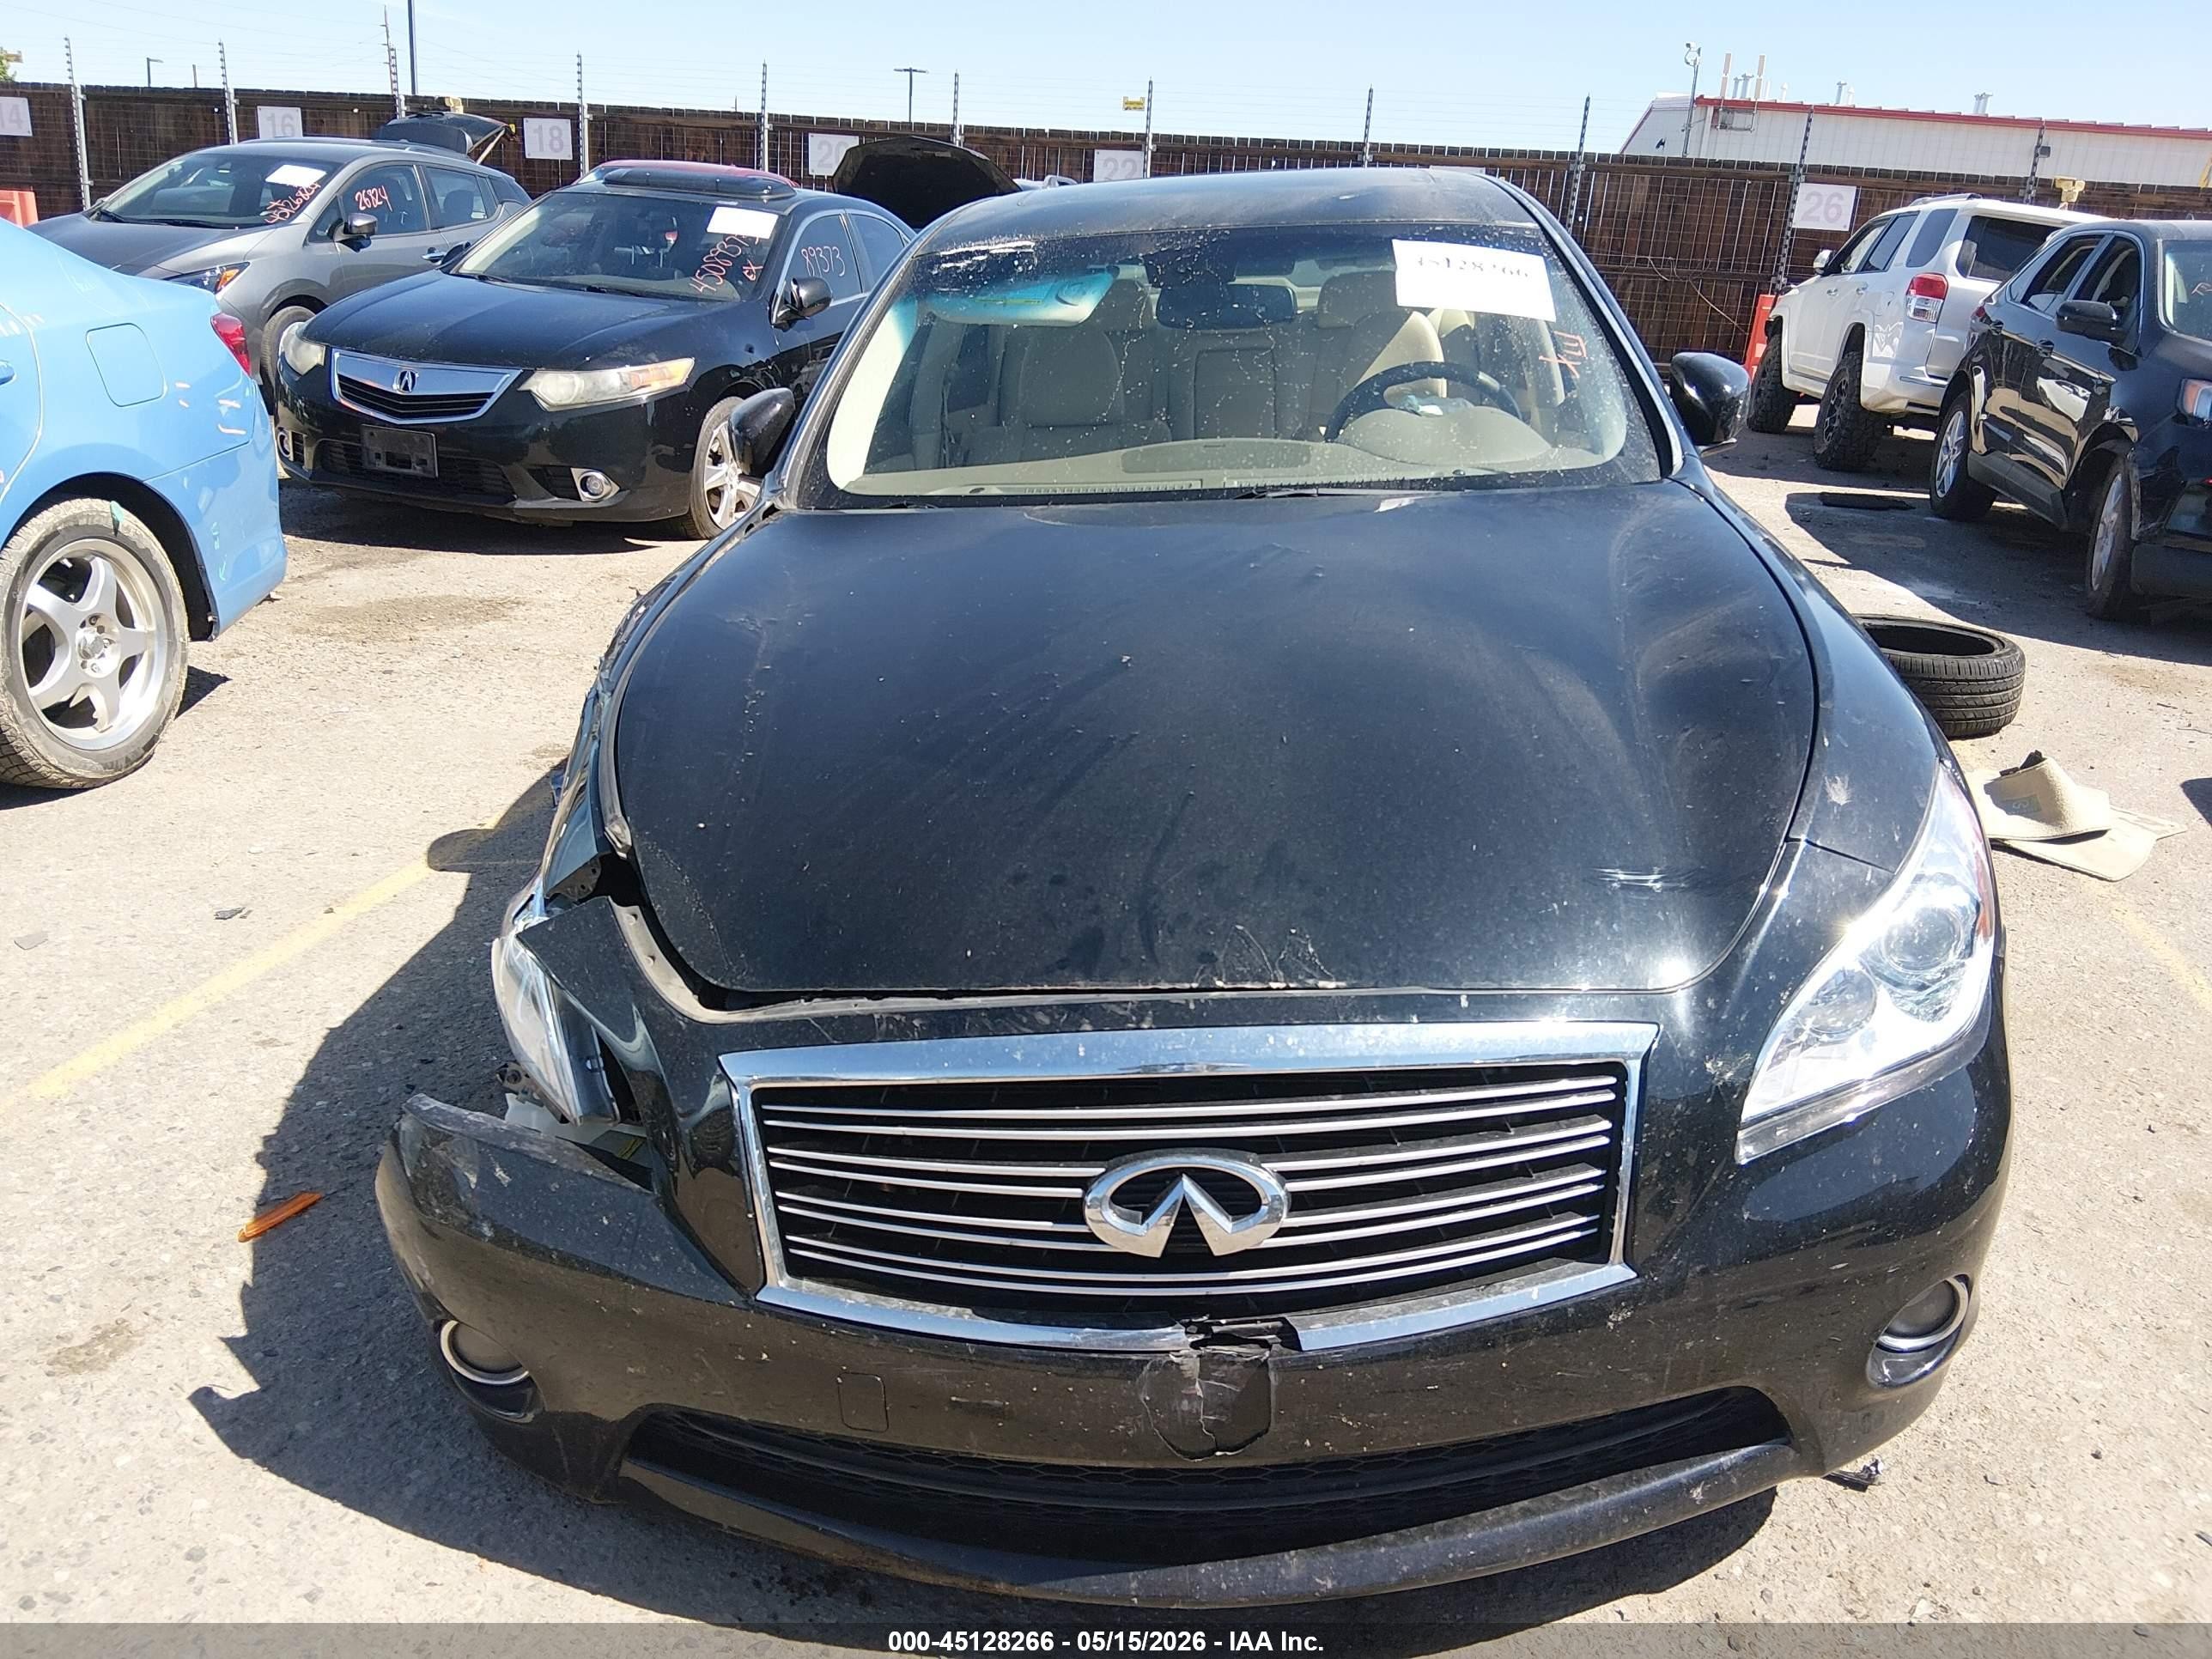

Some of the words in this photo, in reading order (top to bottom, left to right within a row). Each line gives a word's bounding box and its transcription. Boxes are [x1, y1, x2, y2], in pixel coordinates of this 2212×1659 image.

[266, 112, 295, 138] 16
[532, 125, 564, 153] 18
[1103, 156, 1138, 180] 22
[355, 185, 393, 212] 26824
[1801, 191, 1844, 223] 26
[801, 246, 846, 277] 89373
